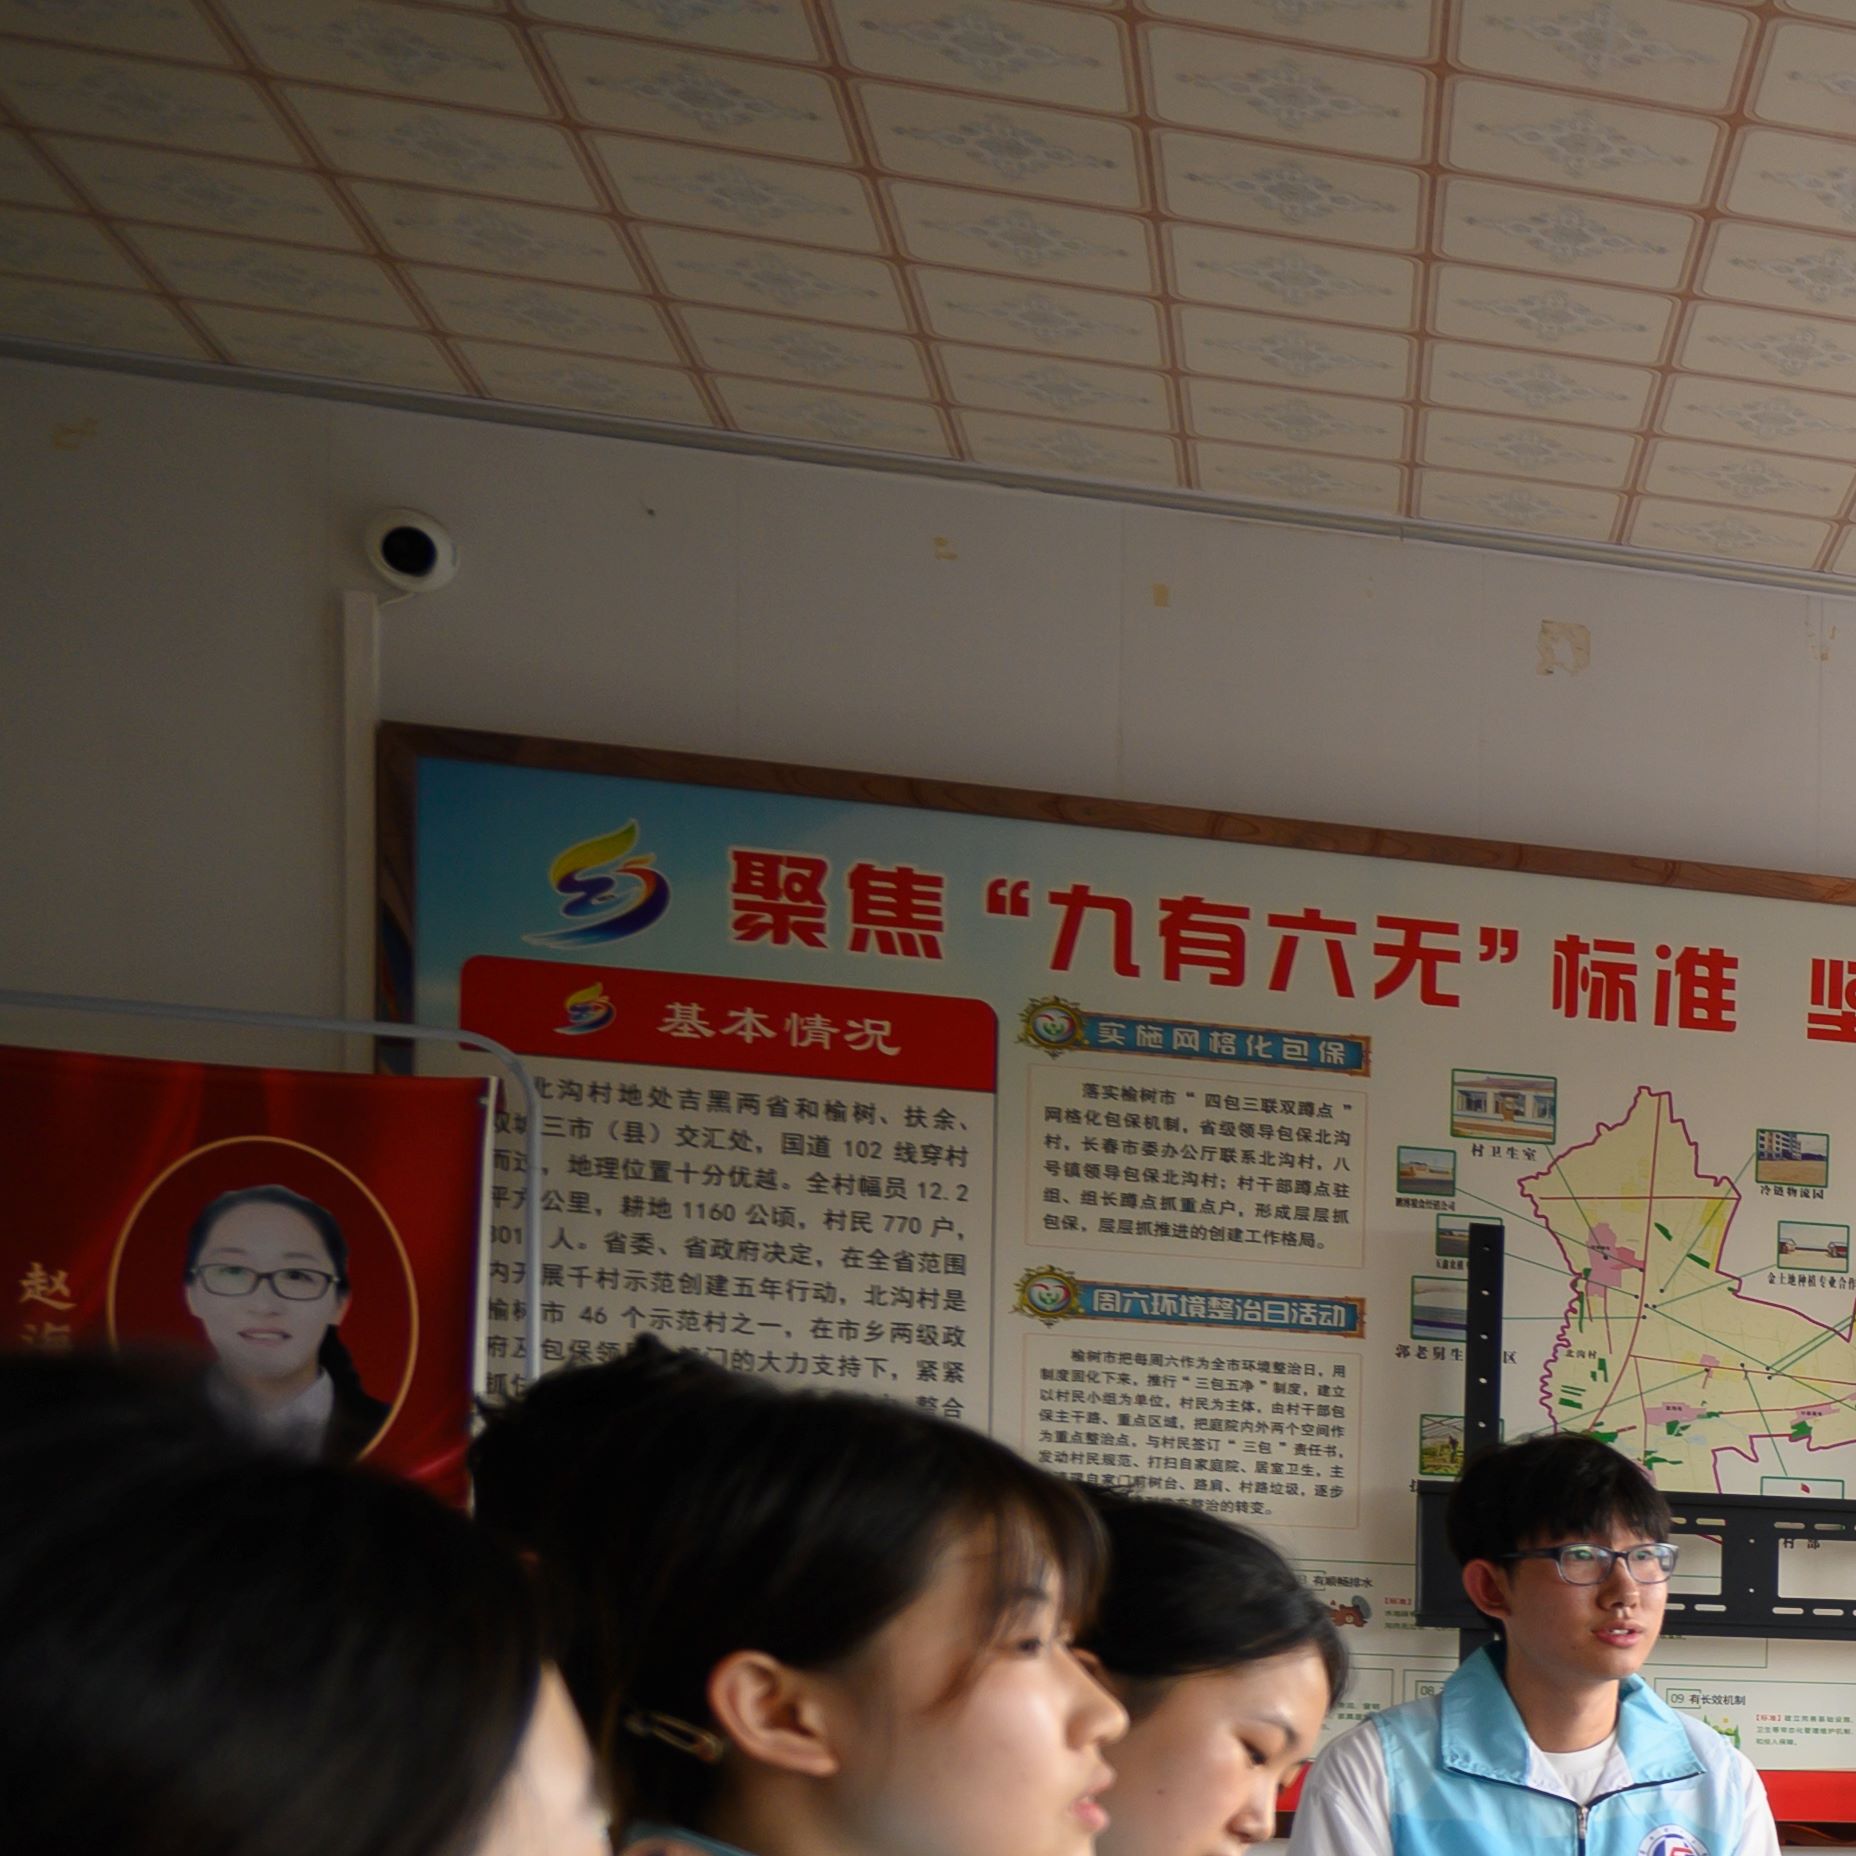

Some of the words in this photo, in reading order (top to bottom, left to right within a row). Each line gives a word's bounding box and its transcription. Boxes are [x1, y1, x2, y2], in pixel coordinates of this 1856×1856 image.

[656, 1001, 902, 1057] 基本情况
[1098, 1022, 1346, 1064] 实施网格化包保
[1472, 1143, 1537, 1162] 村卫生室
[1760, 1186, 1825, 1199] 冷链物流园
[1093, 1290, 1345, 1328] 周六环境整治日活动
[1670, 1693, 1685, 1704] 09
[1689, 1694, 1746, 1706] 有长效机制
